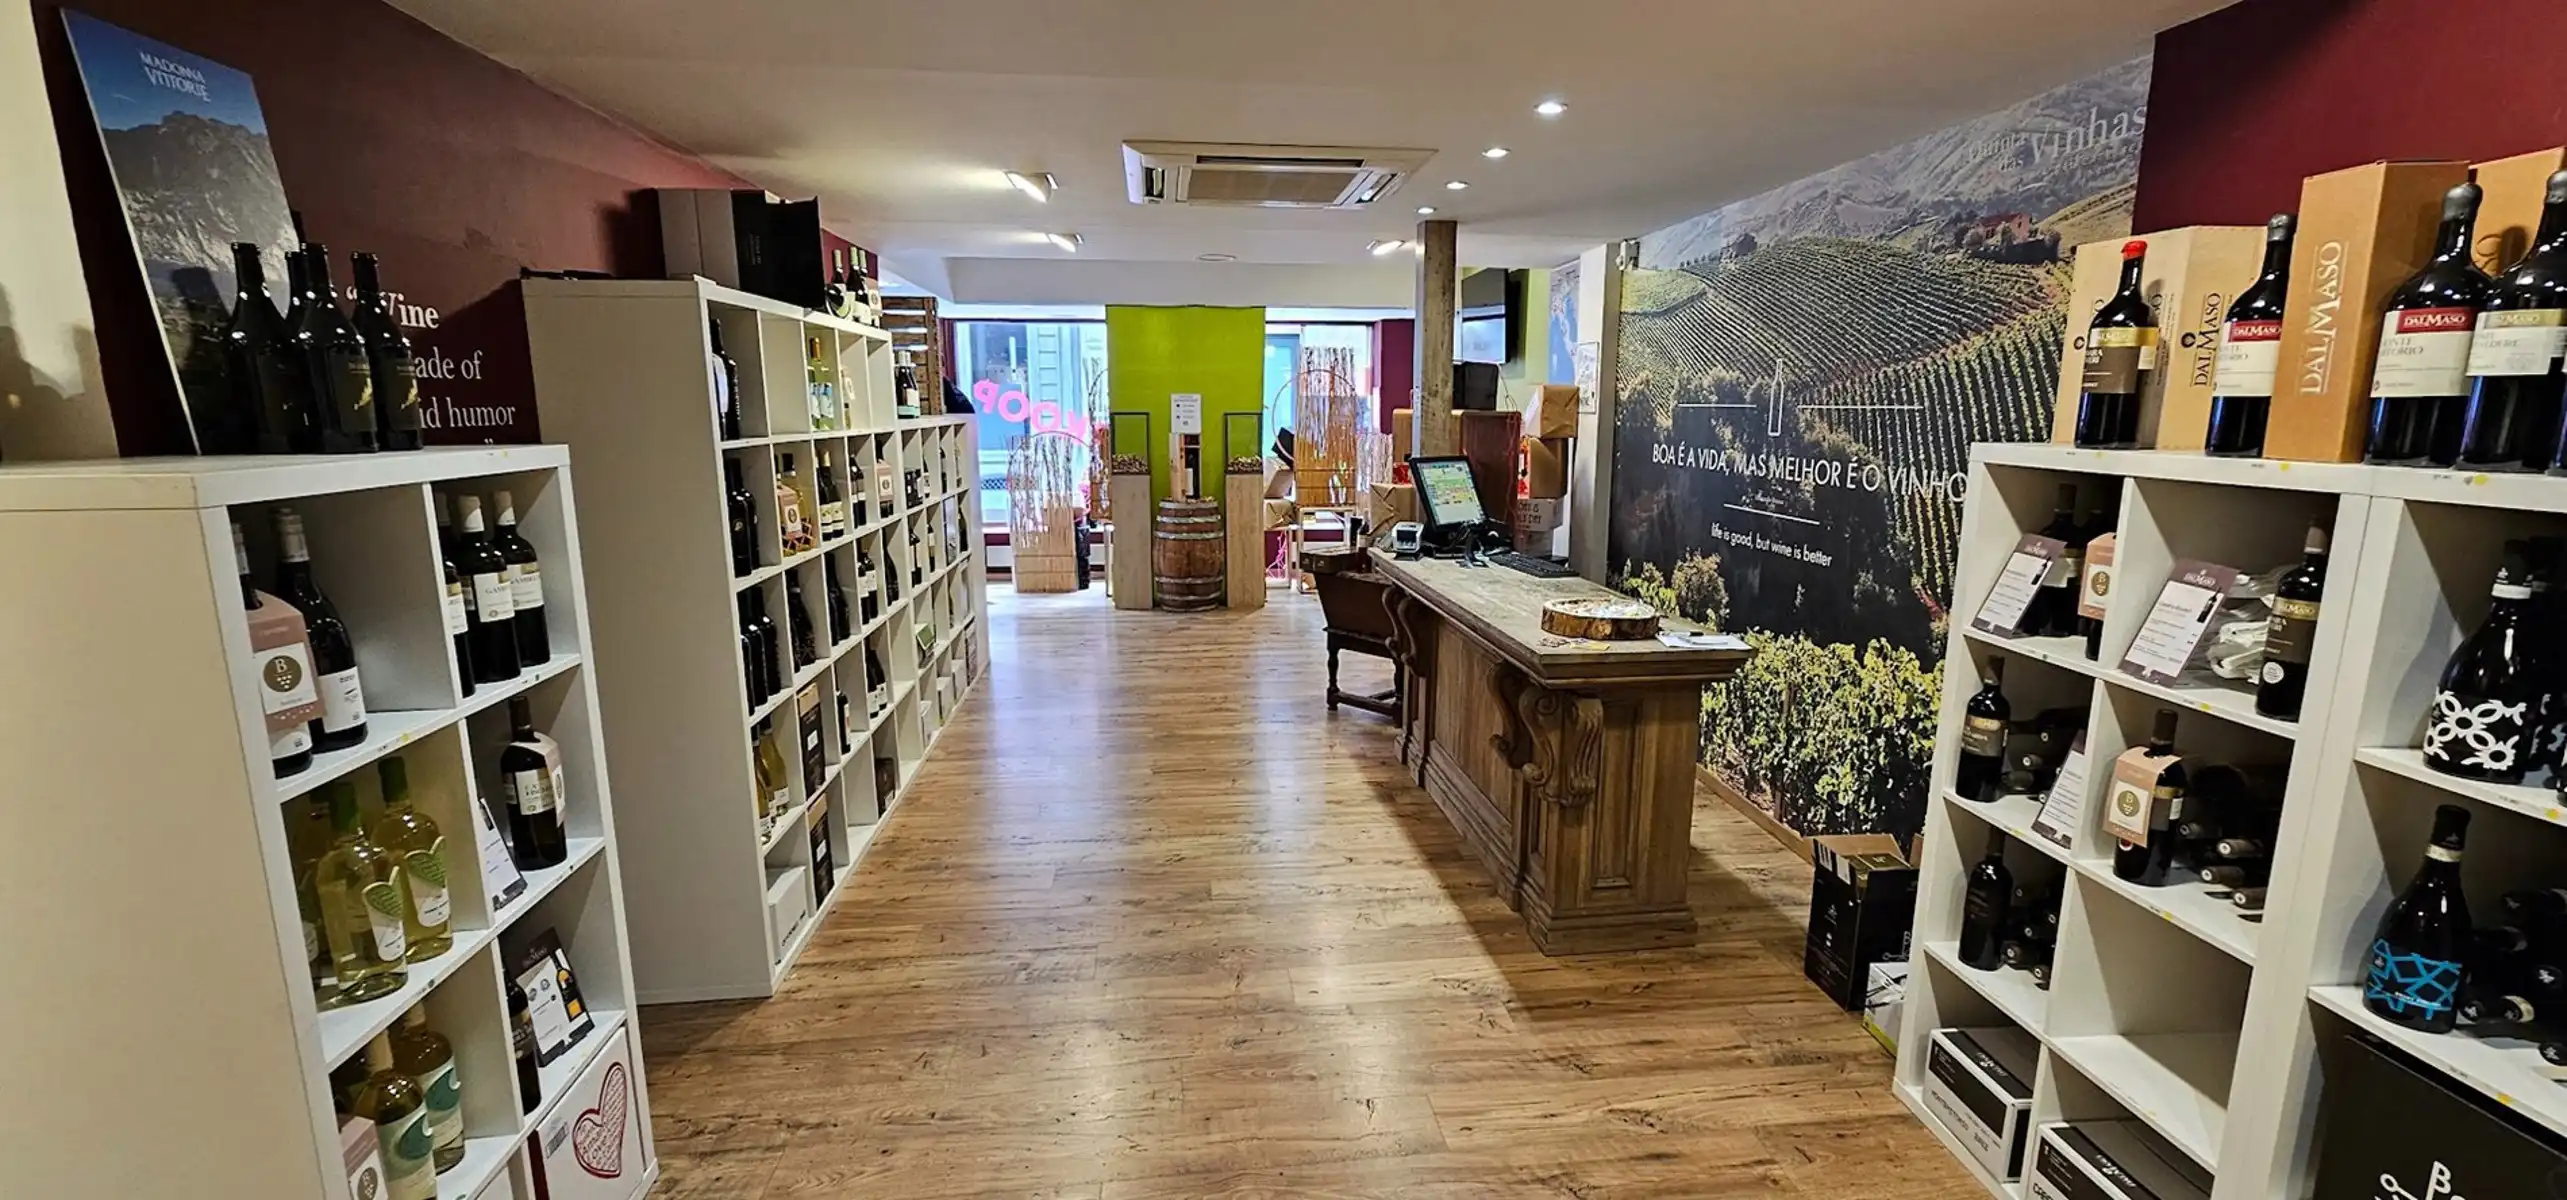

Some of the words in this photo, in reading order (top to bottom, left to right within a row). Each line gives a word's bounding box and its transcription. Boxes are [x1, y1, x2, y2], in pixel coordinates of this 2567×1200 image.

[139, 51, 206, 84] MADONNA
[143, 66, 211, 103] VITTORIE
[2031, 105, 2147, 164] Vinhas
[461, 350, 483, 379] of
[446, 397, 516, 427] humor
[1652, 443, 1675, 465] BOA
[1677, 441, 1686, 466] É
[1686, 447, 1696, 467] A
[1697, 447, 1730, 476] VIDA,
[1733, 452, 1767, 477] MAS
[1768, 455, 1842, 488] MELHOR
[1846, 456, 1859, 489] É
[1862, 463, 1881, 492] O
[1888, 464, 1969, 502] VINHO
[1723, 526, 1730, 541] is
[1730, 531, 1754, 549] good,
[1755, 533, 1770, 551] but
[1770, 540, 1792, 557] wine
[1793, 544, 1802, 560] is
[1803, 543, 1833, 567] better
[275, 658, 288, 674] B
